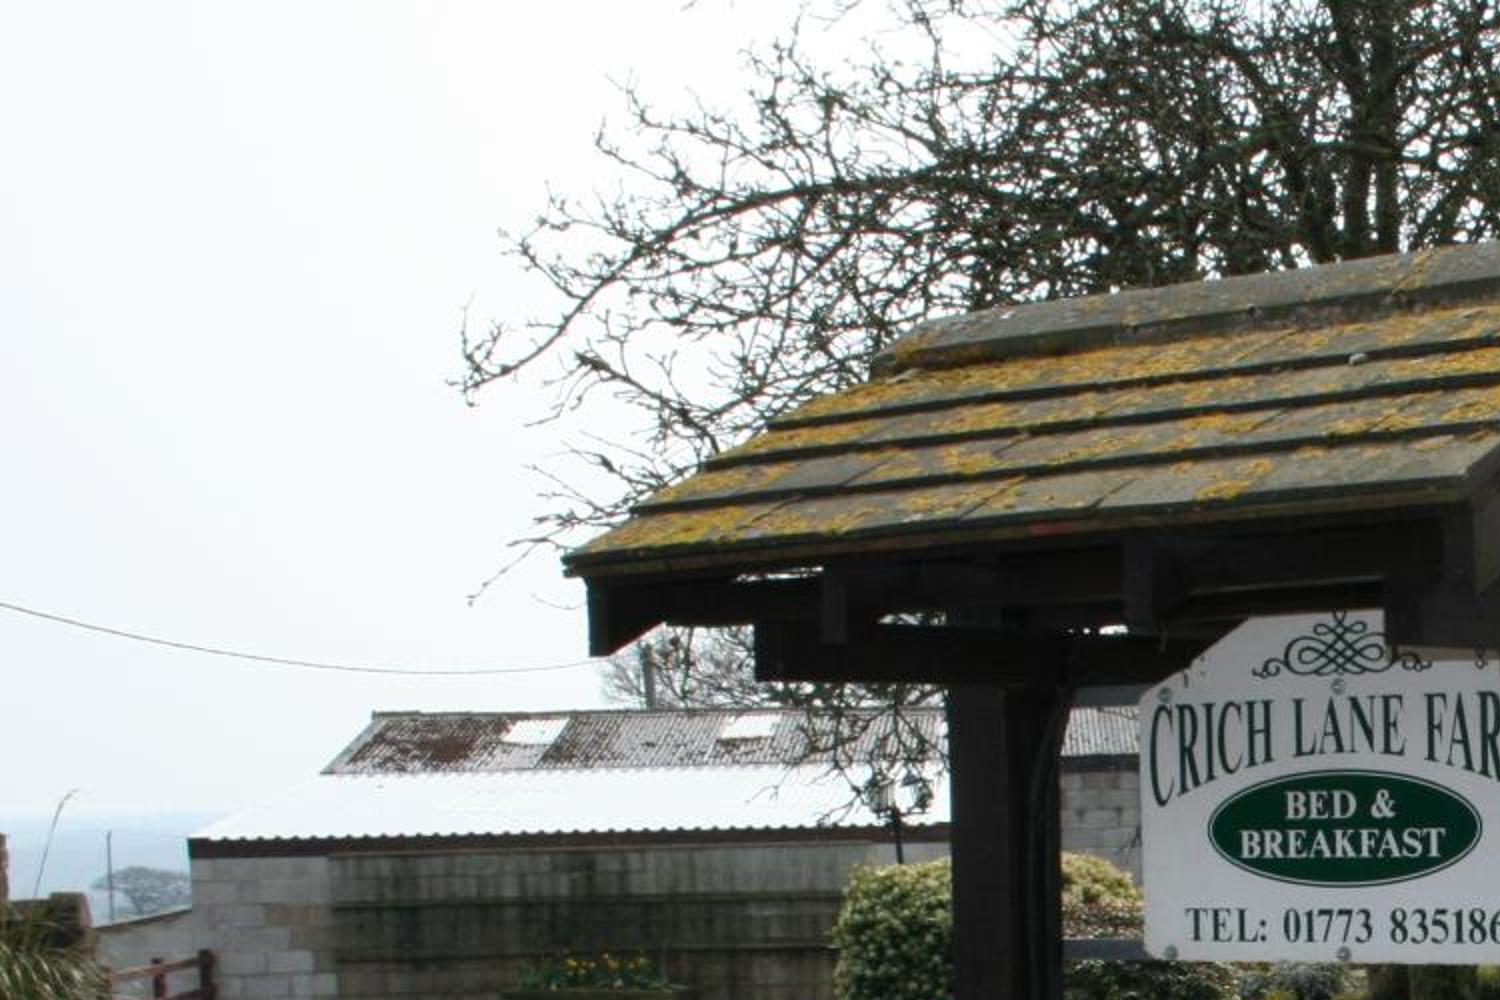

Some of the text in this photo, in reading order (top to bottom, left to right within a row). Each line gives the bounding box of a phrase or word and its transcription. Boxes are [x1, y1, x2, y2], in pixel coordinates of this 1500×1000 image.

[1149, 698, 1274, 807] CRICH
[1292, 694, 1405, 758] LANE
[1285, 788, 1397, 820] BED &
[1240, 827, 1446, 860] BREAKFAST
[1185, 908, 1267, 943] TEL:
[1283, 908, 1374, 944] 01773
